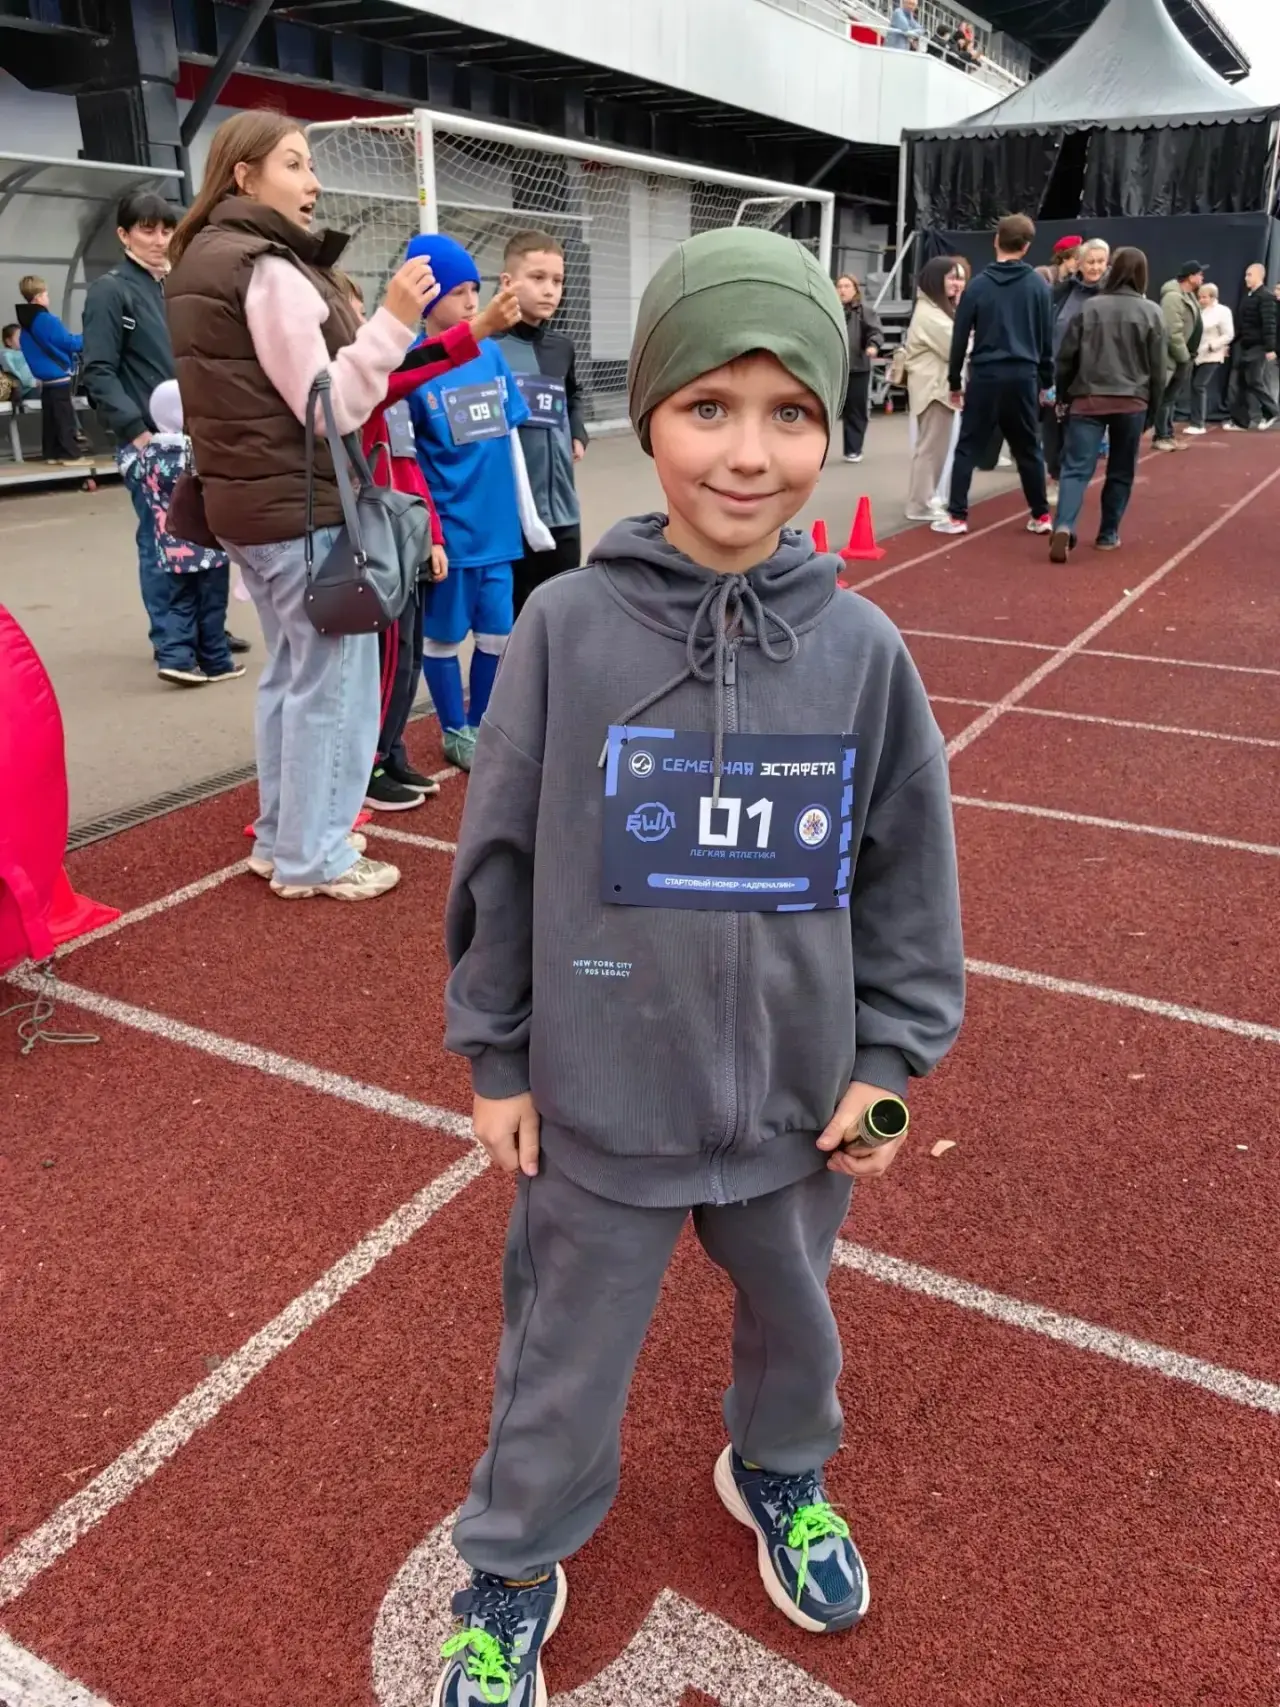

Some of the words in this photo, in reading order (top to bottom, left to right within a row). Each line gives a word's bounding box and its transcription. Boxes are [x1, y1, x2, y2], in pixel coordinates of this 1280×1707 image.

[536, 393, 553, 411] 13
[469, 402, 491, 422] 09
[760, 762, 836, 777] ЭСТАФЕТА
[698, 796, 774, 849] 01
[690, 848, 726, 859] ЛЕГКАЯ
[728, 851, 776, 859] АТЛЕТИКА
[664, 877, 711, 888] СТАРТОВЫЙ
[573, 959, 591, 968] NEW
[592, 960, 615, 969] YORK
[616, 962, 633, 970] CITY
[601, 969, 631, 978] LEGACY
